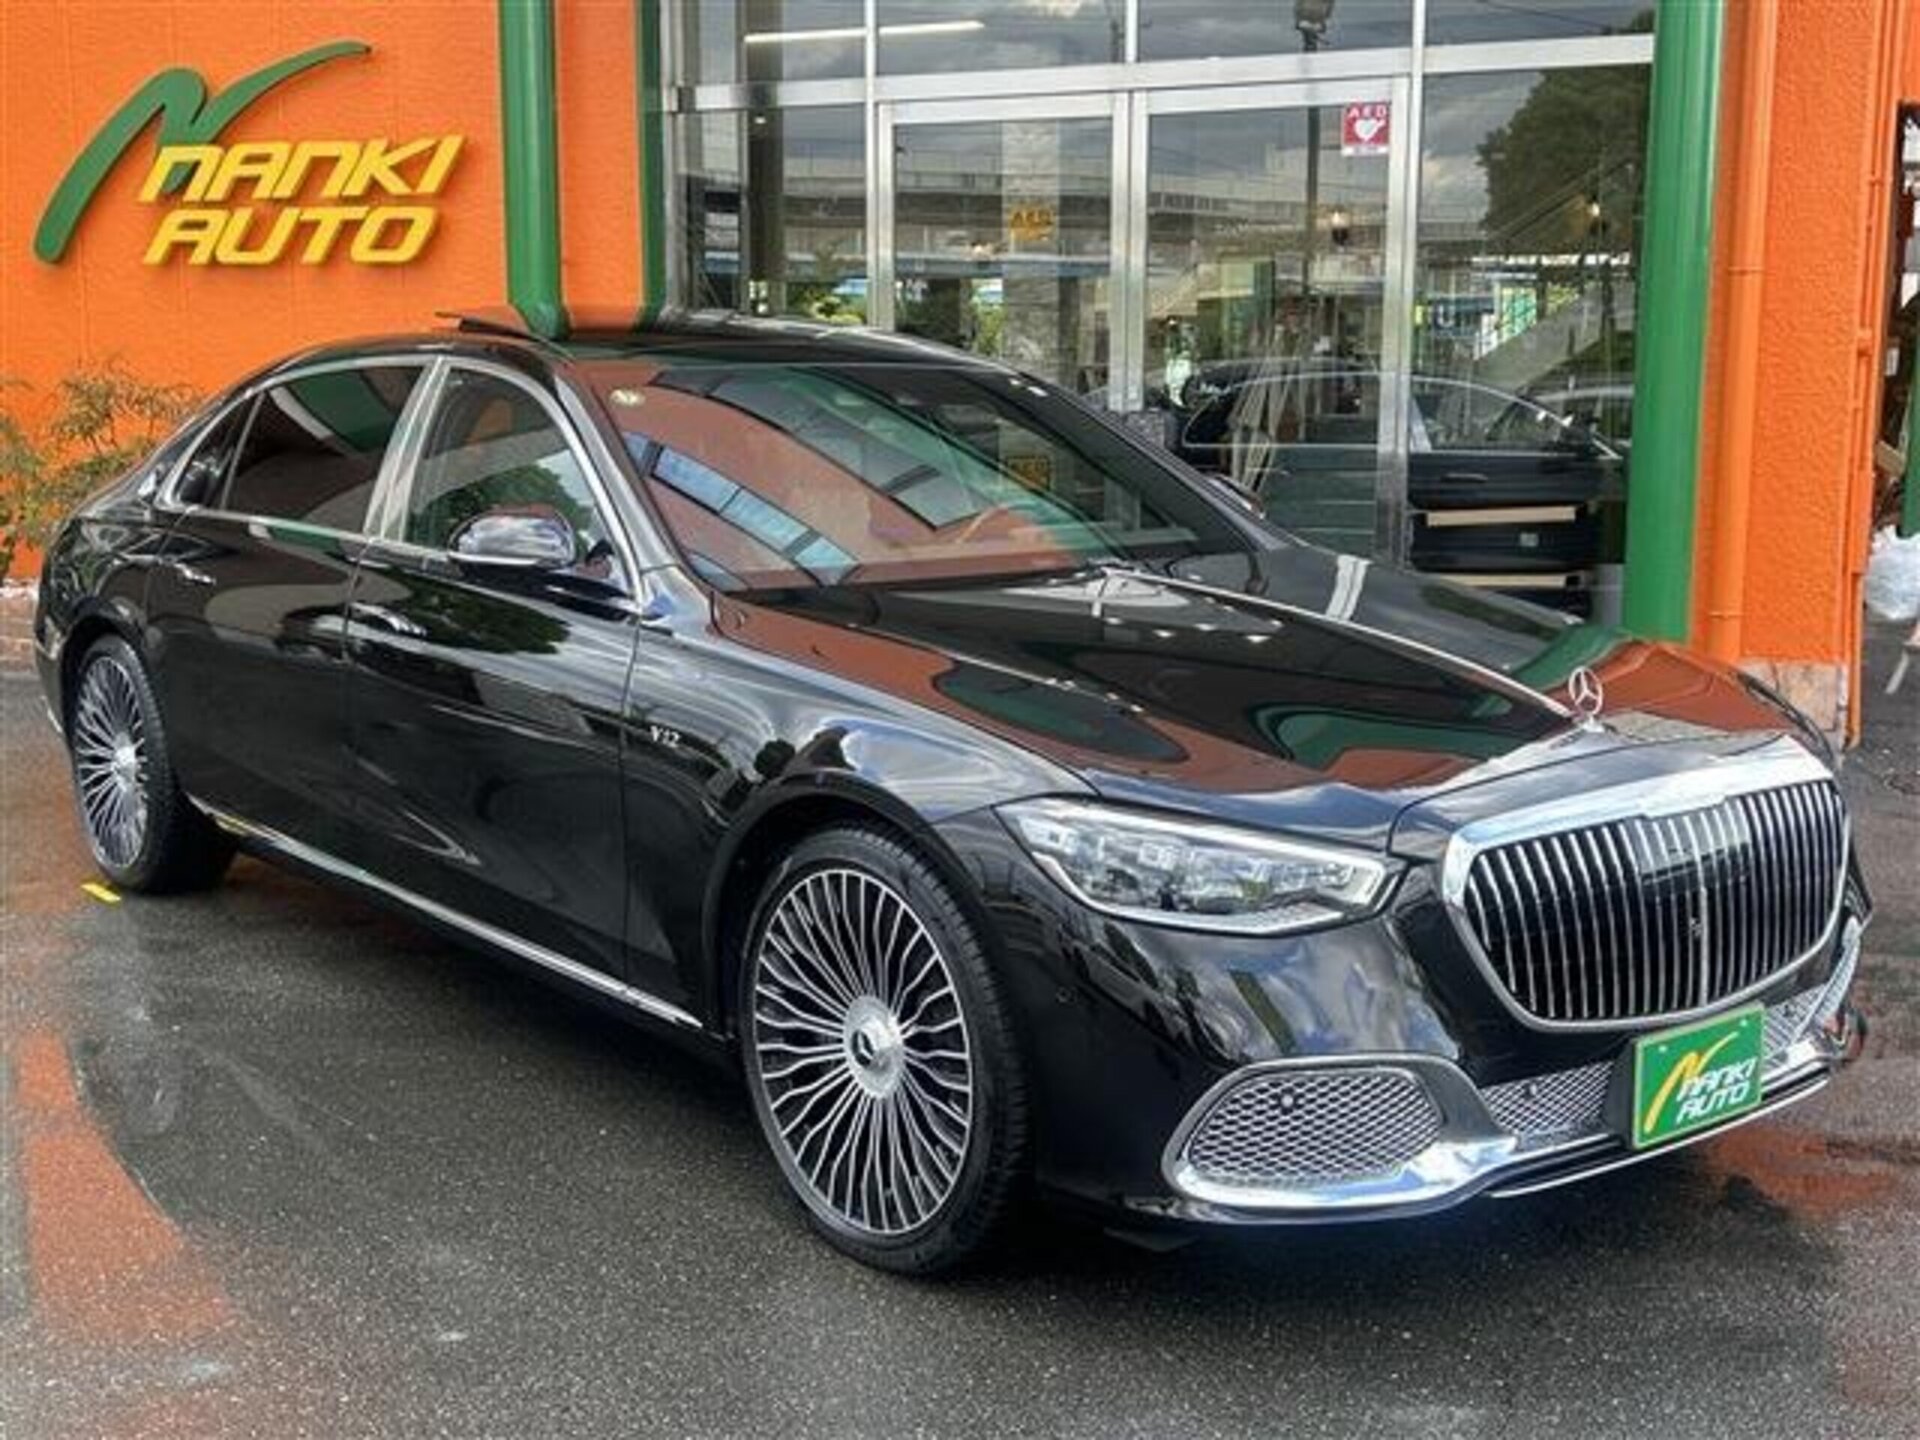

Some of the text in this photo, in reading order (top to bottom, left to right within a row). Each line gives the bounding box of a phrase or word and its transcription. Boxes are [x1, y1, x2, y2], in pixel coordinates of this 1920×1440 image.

[138, 133, 466, 203] NANKI
[142, 206, 441, 266] AUTO
[1676, 1057, 1758, 1101] NANKI
[1676, 1080, 1751, 1123] AUTO
